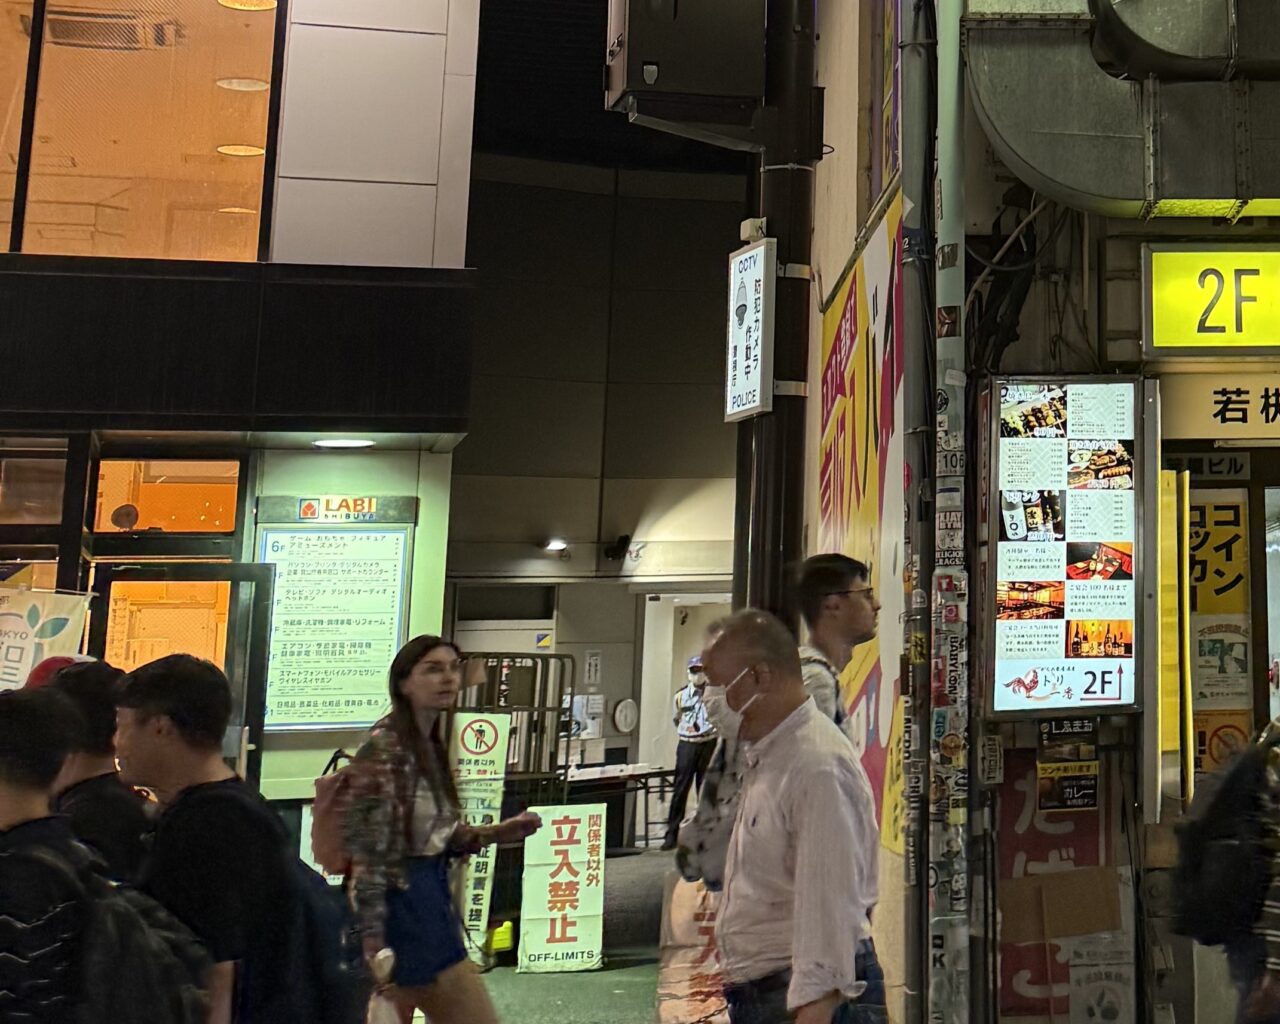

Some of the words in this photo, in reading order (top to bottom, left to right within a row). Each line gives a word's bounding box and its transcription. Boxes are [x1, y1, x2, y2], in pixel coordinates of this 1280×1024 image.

[738, 253, 758, 275] CCTV
[1196, 268, 1260, 334] 2F
[732, 389, 757, 410] POLICE
[325, 498, 372, 512] LABI
[271, 540, 286, 552] 6F
[1213, 504, 1244, 596] コイン
[1083, 671, 1113, 695] 2F
[586, 814, 601, 887] 関係者以外
[546, 815, 582, 945] 立入禁止
[528, 950, 595, 963] OFF-LIMITS
